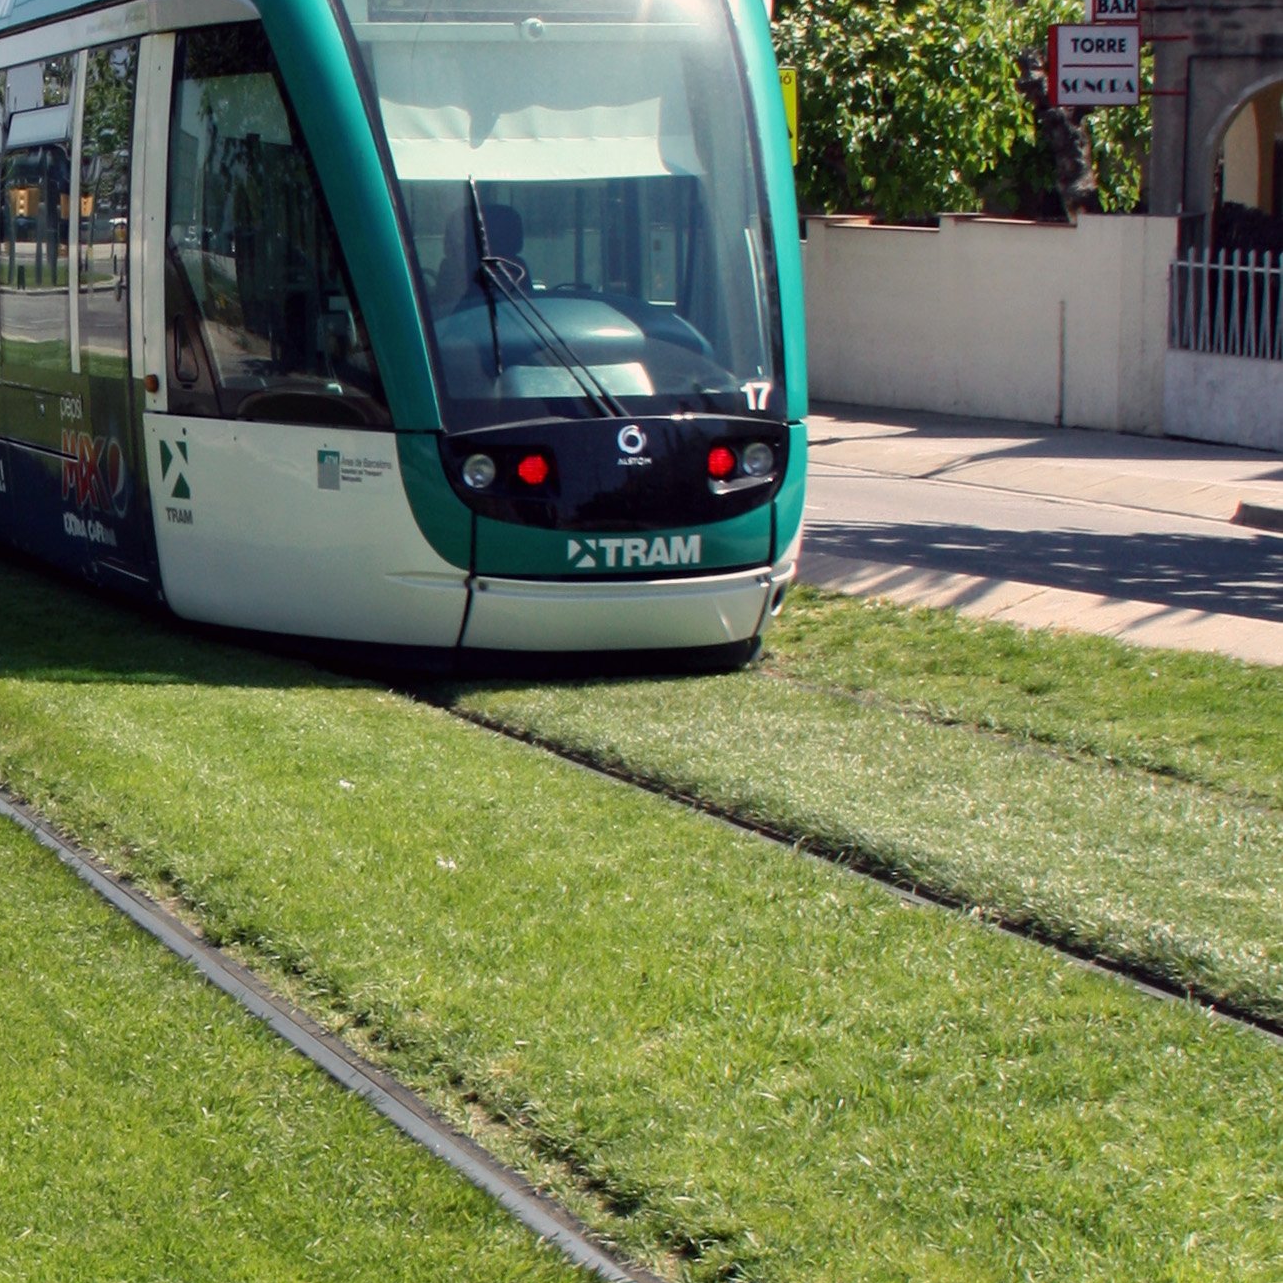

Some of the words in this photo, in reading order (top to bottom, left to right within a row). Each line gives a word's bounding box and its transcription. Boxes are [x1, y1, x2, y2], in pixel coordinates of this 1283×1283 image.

[1071, 37, 1127, 54] TORRE
[1061, 78, 1135, 94] SONORA
[59, 393, 83, 421] pepsi
[740, 381, 772, 411] 17
[60, 428, 115, 513] MAX
[617, 456, 653, 467] ALSTOM
[165, 507, 193, 525] TRAM
[598, 534, 701, 567] TRAM
